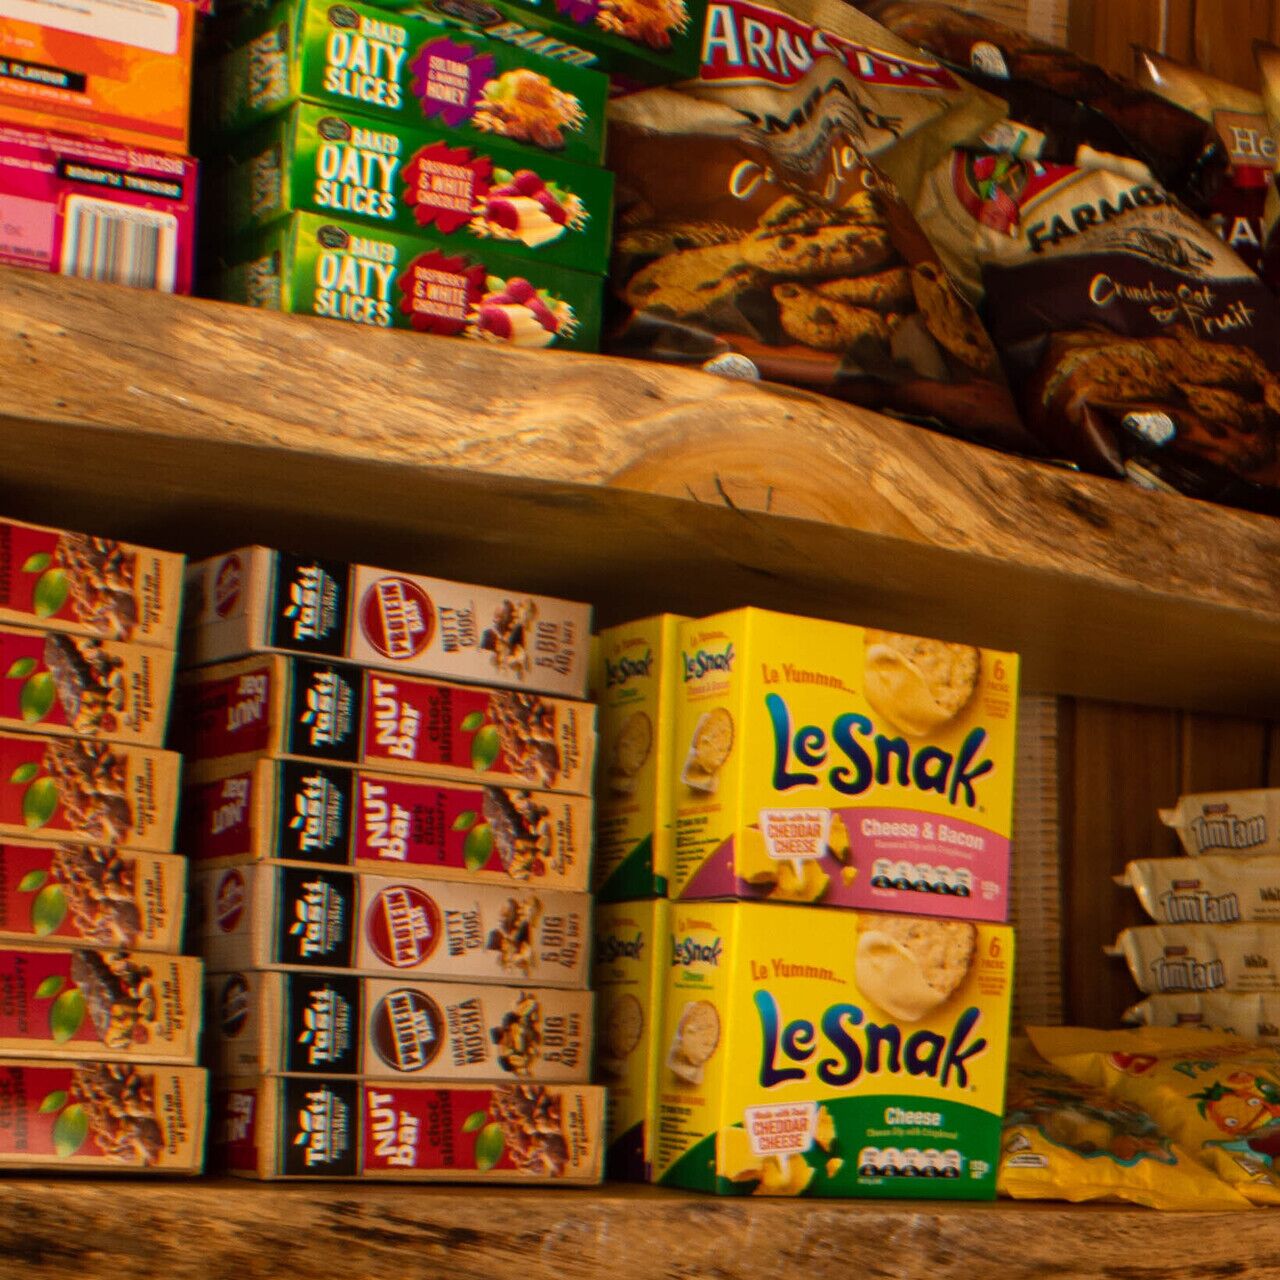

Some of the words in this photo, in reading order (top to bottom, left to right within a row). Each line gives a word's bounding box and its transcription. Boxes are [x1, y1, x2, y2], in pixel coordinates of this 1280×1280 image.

[326, 30, 408, 83] OATY
[324, 67, 402, 110] SLICES
[317, 141, 400, 195] OATY
[313, 177, 396, 221] SLICES
[315, 250, 396, 301] OATY
[313, 287, 393, 327] SLICES
[310, 669, 335, 747] Tasti
[372, 679, 399, 746] NUT
[389, 703, 421, 760] bar
[766, 692, 993, 808] LeSnak
[363, 782, 387, 847] NUT
[379, 804, 411, 861] bar
[862, 818, 917, 838] Cheese
[922, 824, 934, 839] &
[939, 826, 984, 851] Bacon
[299, 876, 323, 958] Tasti
[308, 985, 339, 1066] Tasti
[462, 998, 489, 1064] MOCHA
[753, 989, 987, 1091] LeSnak
[307, 1088, 335, 1167] Tasti
[368, 1091, 398, 1157] NUT
[389, 1111, 418, 1168] bar
[885, 1106, 942, 1126] Cheese
